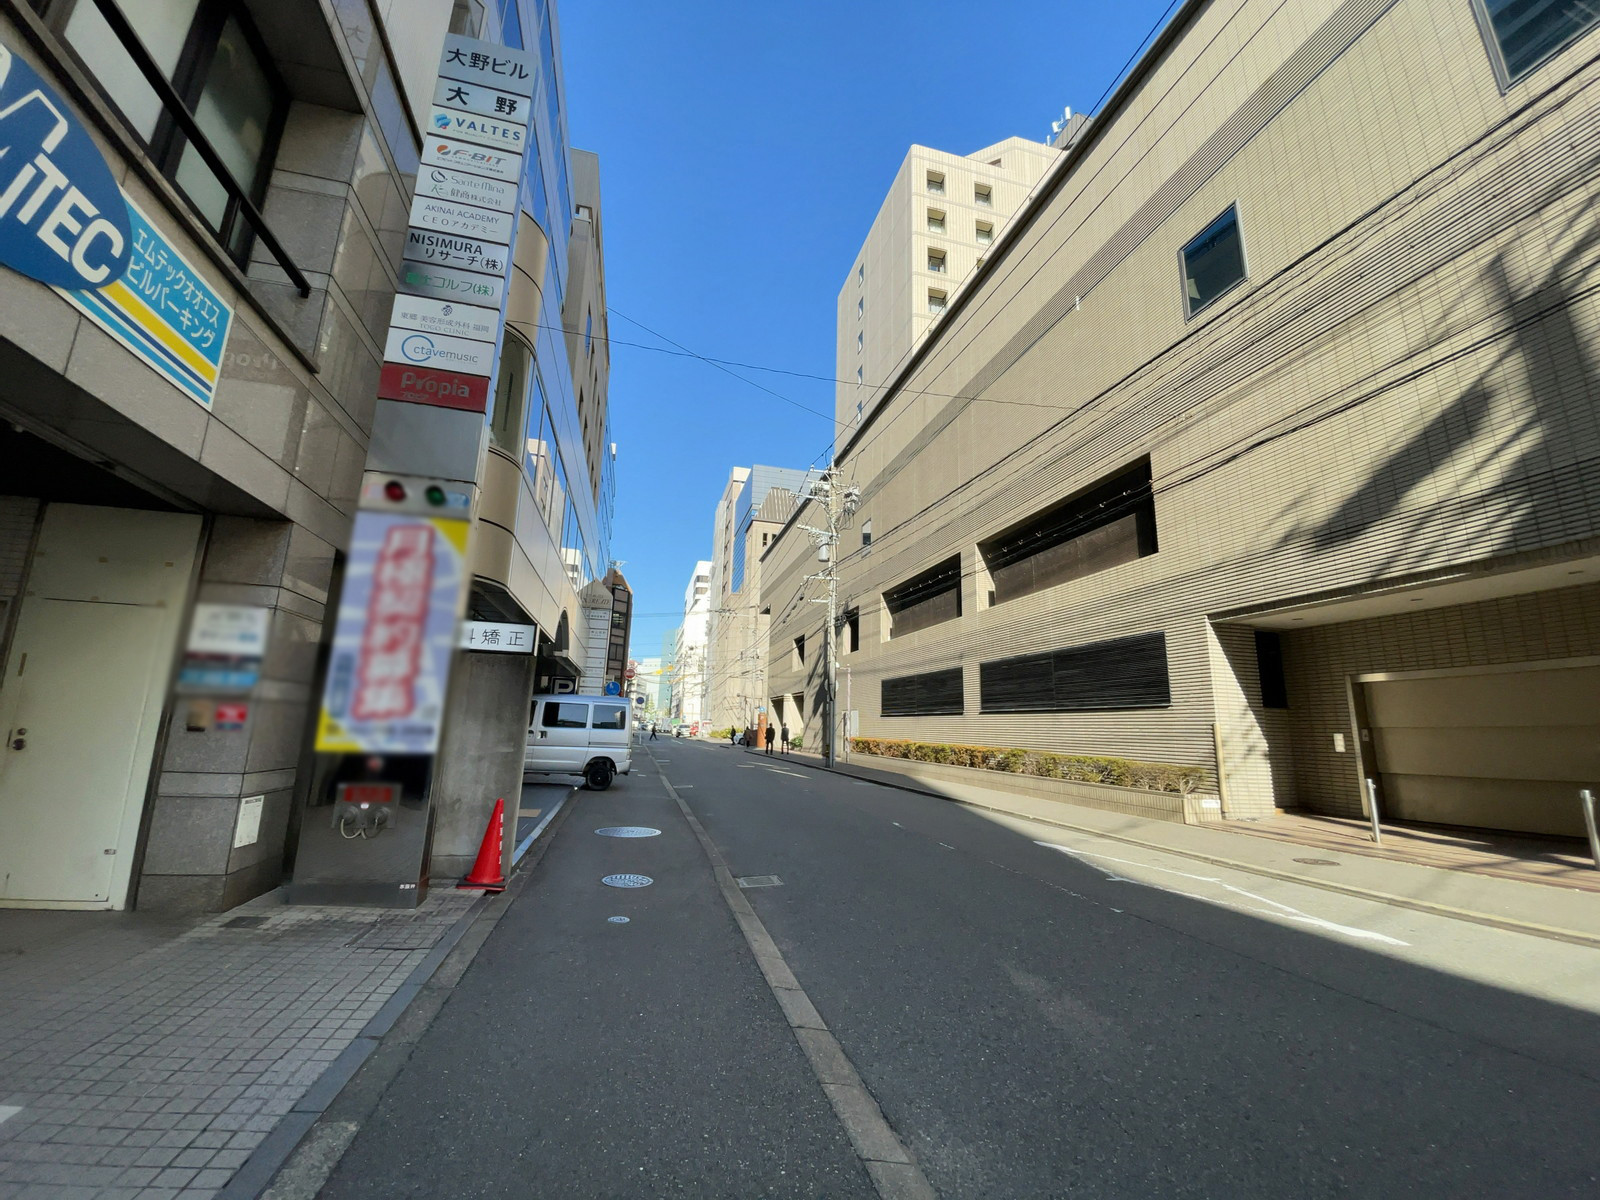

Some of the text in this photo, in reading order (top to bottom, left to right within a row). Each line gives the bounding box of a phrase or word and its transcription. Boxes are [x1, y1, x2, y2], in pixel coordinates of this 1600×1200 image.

[446, 48, 529, 79] 大野ビル
[456, 117, 521, 140] VALTES
[424, 204, 500, 225] AKINAI ACADEMY
[410, 232, 483, 256] NISIMURA
[425, 247, 503, 272] リサーチ(株)
[134, 228, 219, 328] エムテックオオエス
[127, 255, 216, 347] ビルパーキング
[400, 371, 470, 399] Propia
[553, 679, 574, 694] P
